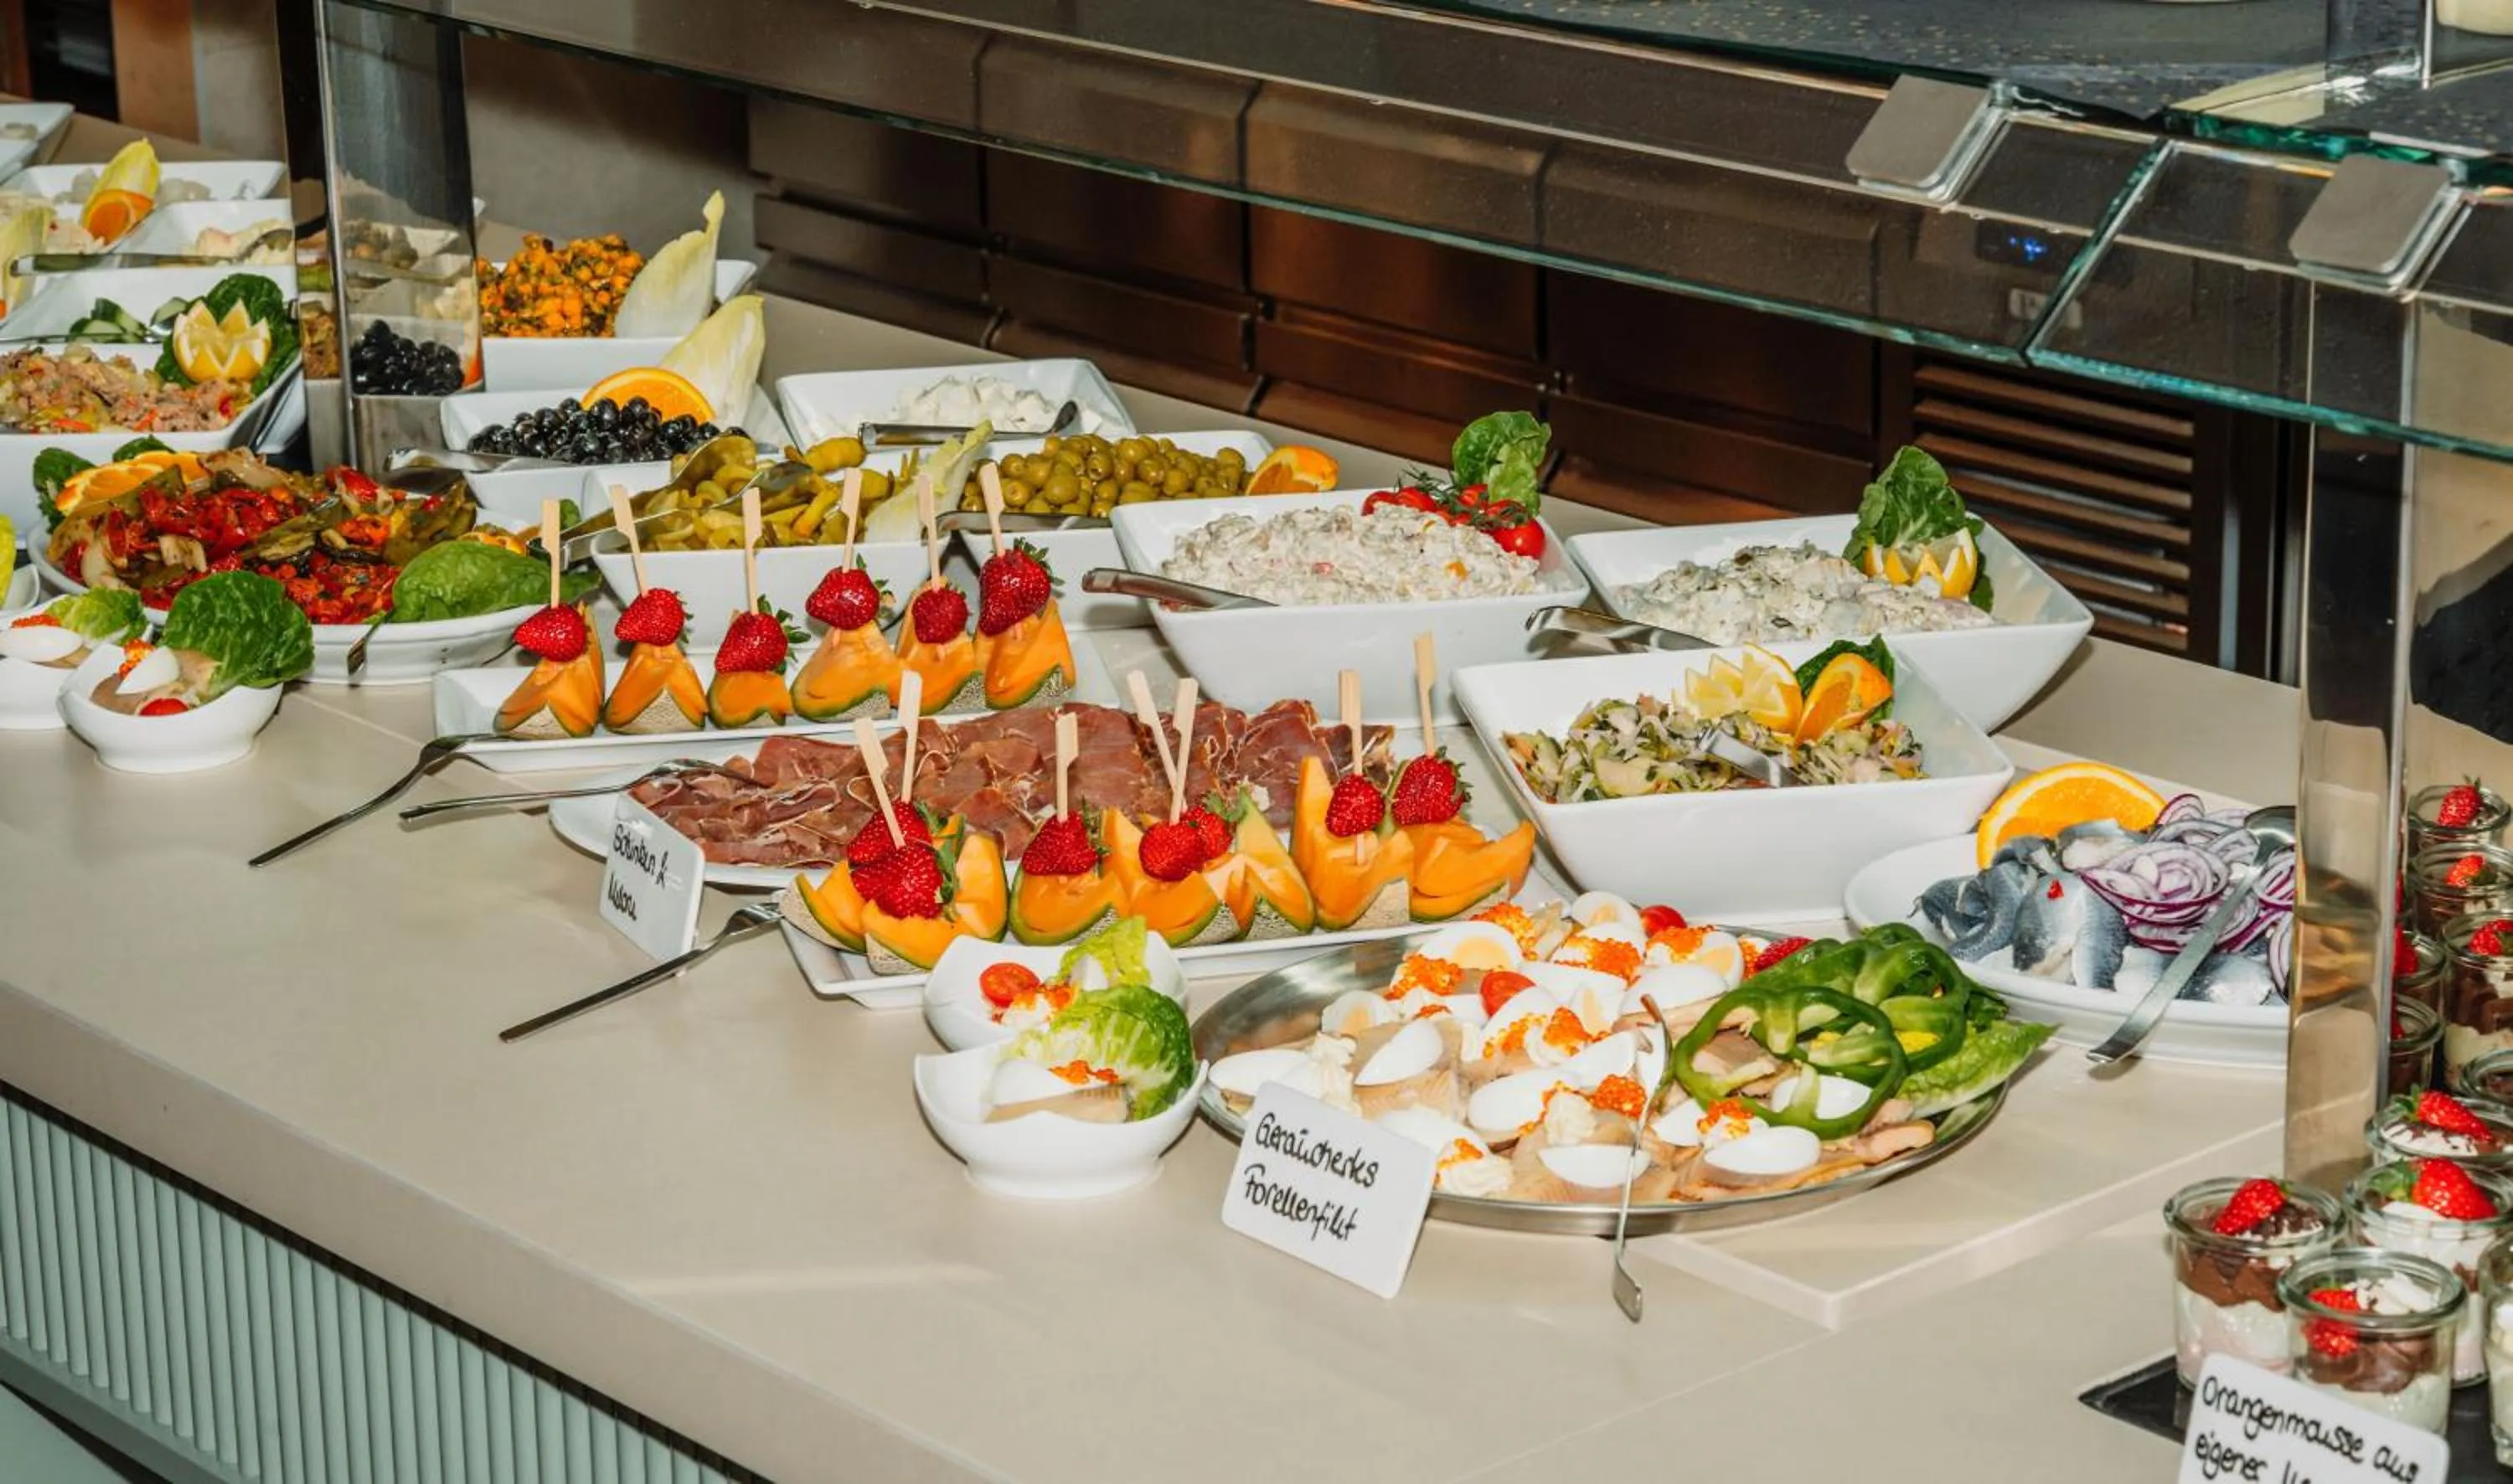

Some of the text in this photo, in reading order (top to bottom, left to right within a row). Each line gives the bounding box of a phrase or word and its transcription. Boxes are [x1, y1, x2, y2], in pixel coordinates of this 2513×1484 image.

[1244, 1163, 1359, 1241] Forellenfilet
[2195, 1430, 2269, 1482] eigener
[2372, 1445, 2420, 1484] aus
